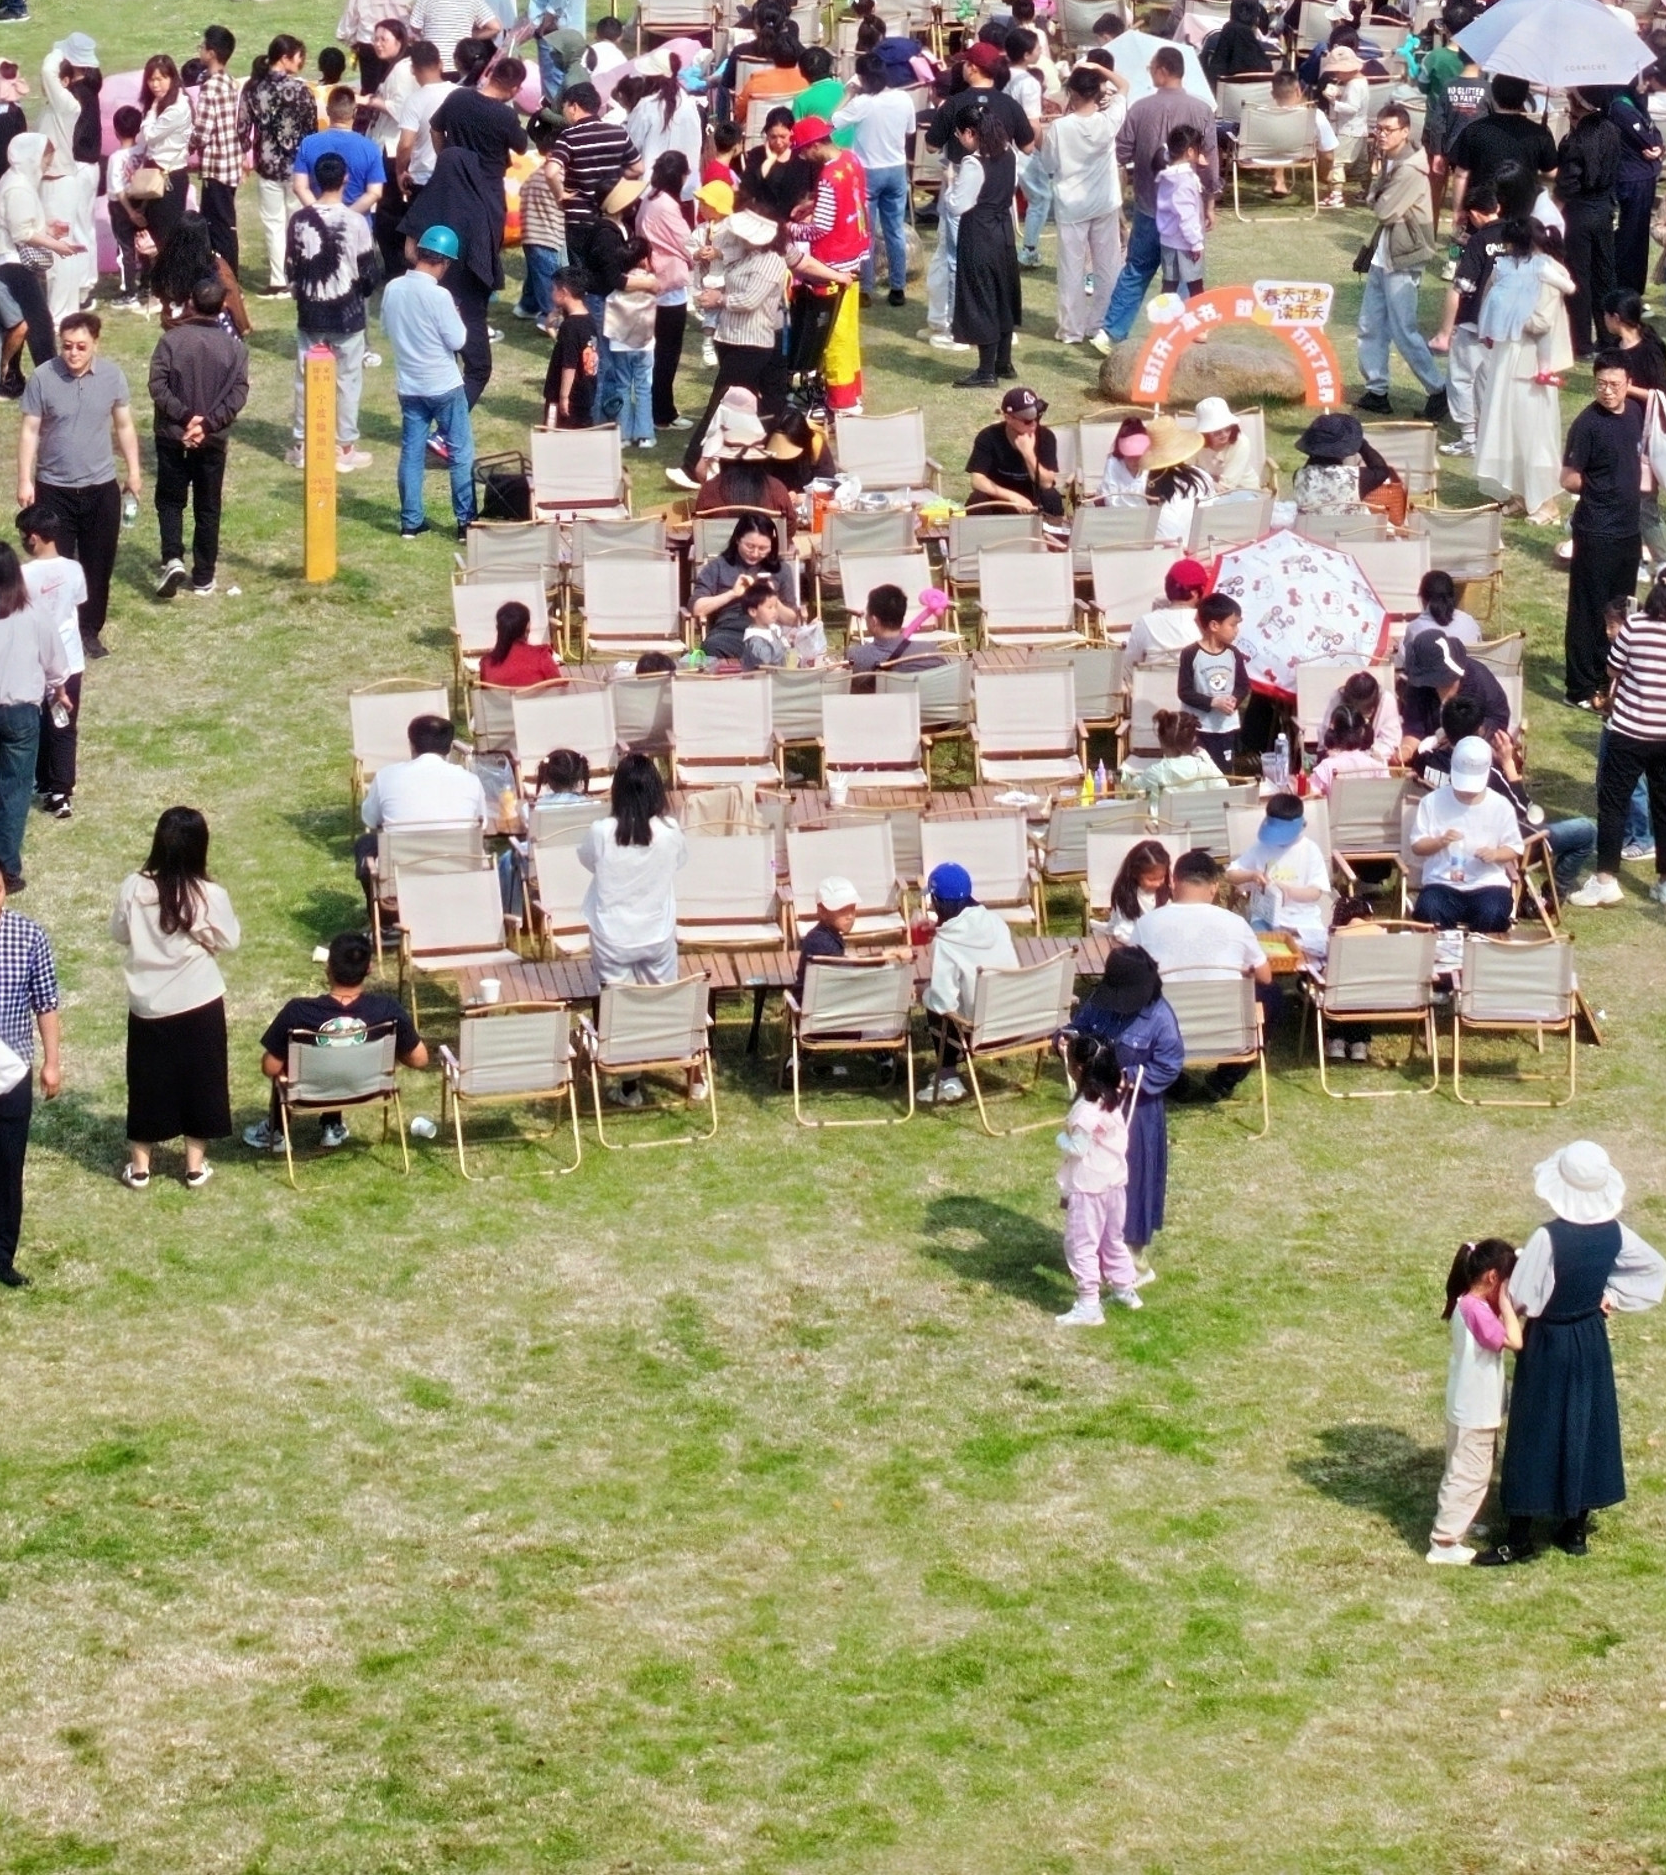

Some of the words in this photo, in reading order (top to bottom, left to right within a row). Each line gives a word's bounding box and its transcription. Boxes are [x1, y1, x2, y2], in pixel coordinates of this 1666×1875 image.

[1460, 95, 1481, 103] PARTY
[1276, 304, 1325, 321] 读书天
